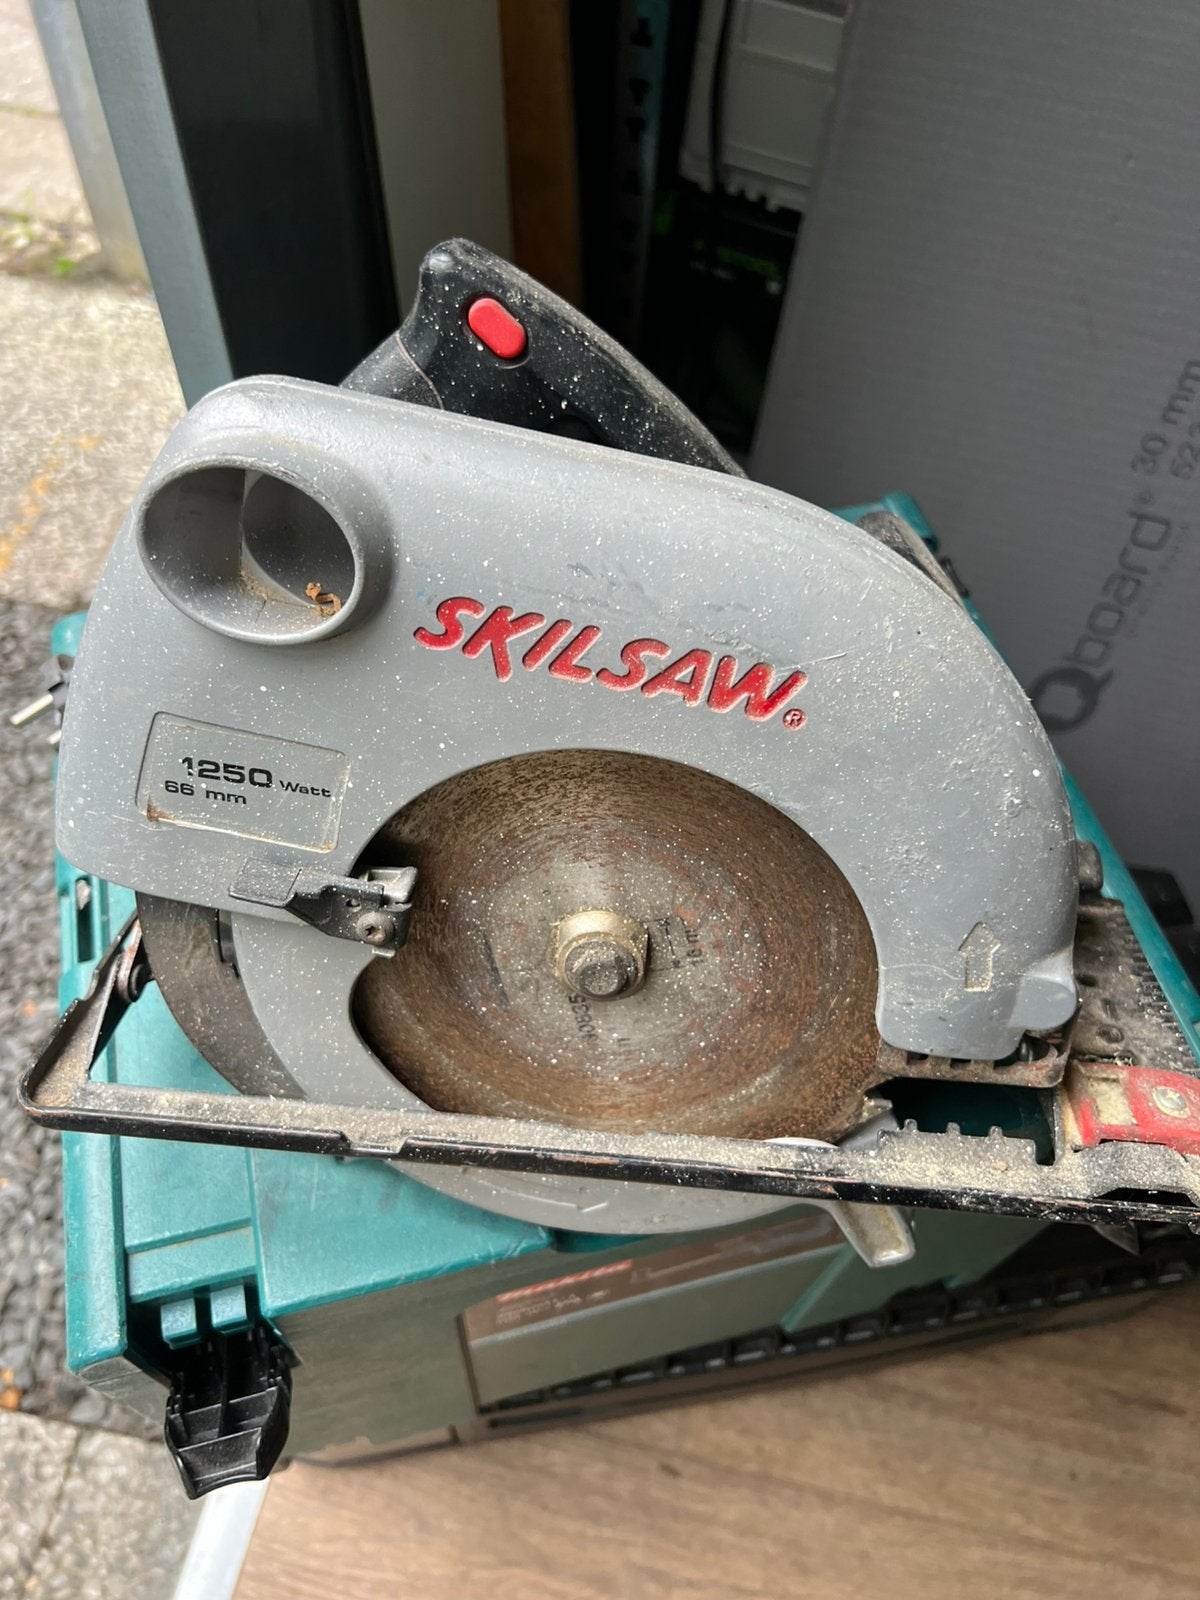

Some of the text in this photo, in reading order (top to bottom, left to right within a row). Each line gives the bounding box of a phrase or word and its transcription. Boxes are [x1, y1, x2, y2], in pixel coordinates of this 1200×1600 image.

[1161, 360, 1200, 426] mm
[164, 780, 247, 805] 66 mm
[181, 756, 332, 798] 1250 Watt
